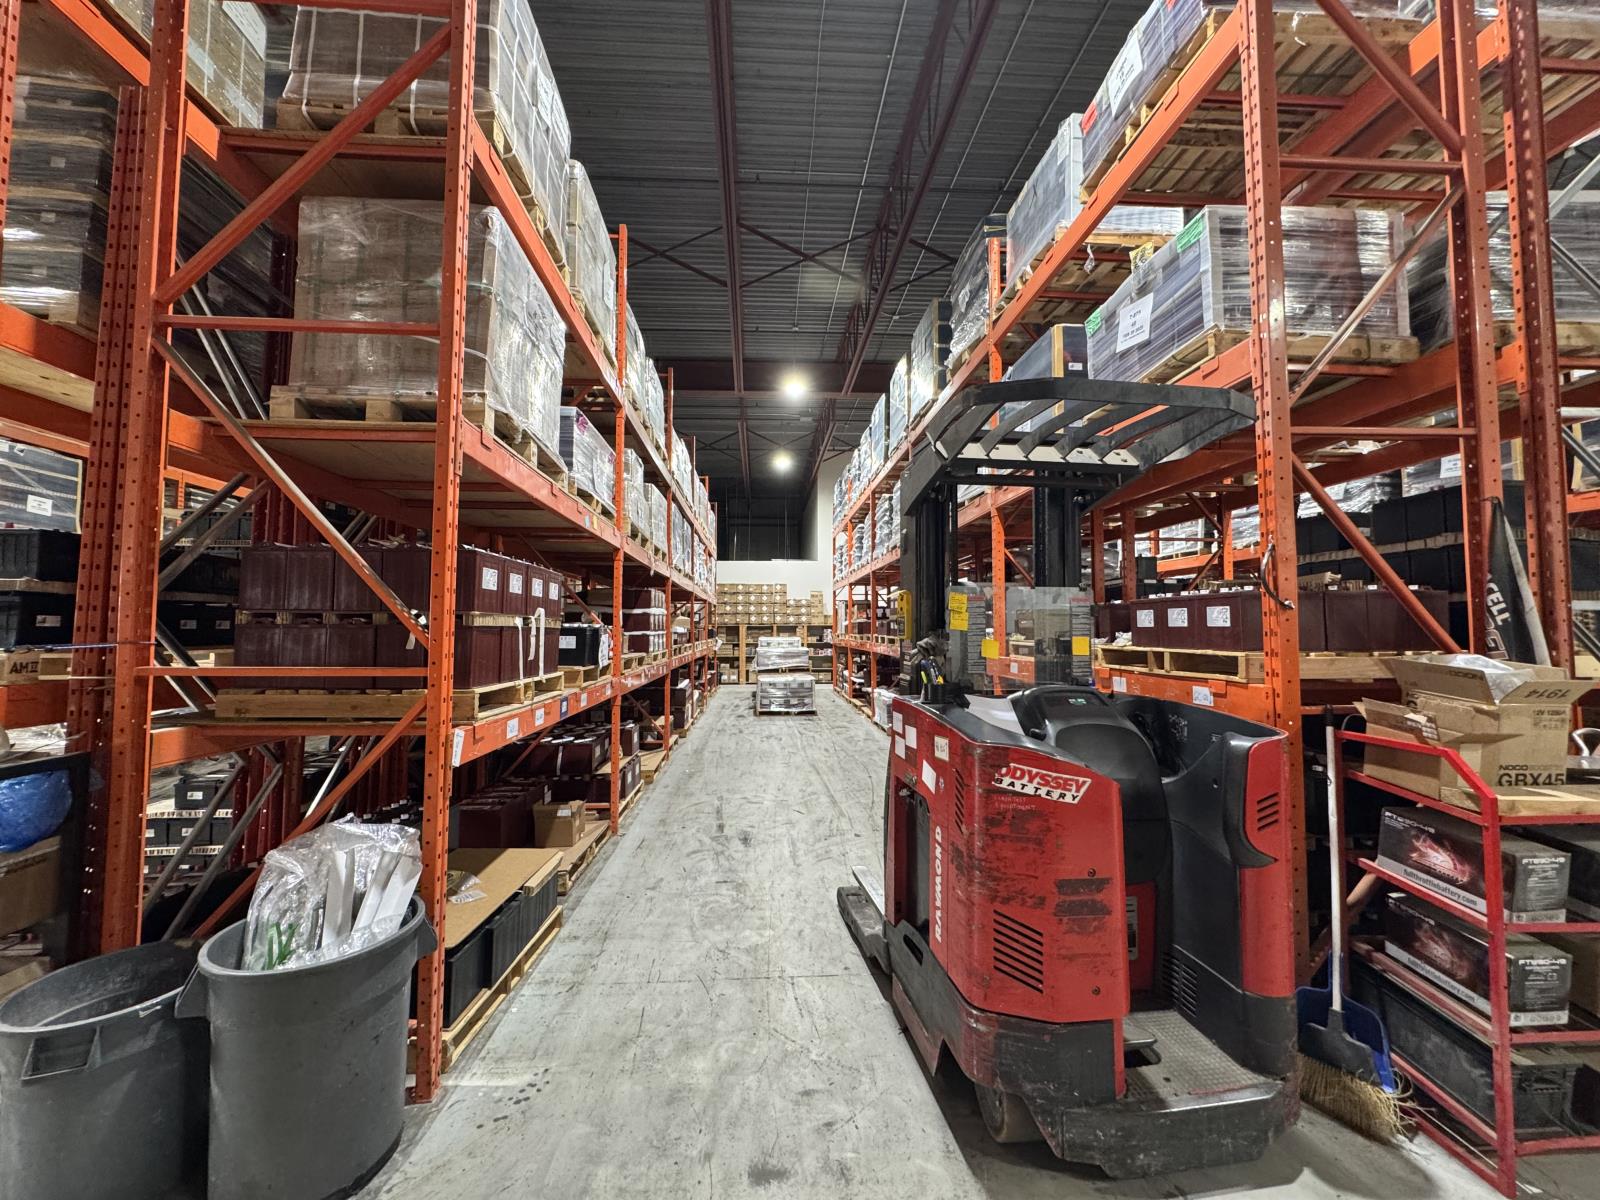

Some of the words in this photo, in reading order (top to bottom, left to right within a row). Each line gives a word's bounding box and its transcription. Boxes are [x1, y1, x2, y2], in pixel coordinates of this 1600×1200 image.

[1486, 573, 1511, 626] CELL
[994, 778, 1080, 802] BATTERY
[996, 766, 1089, 793] ODYSSEY
[1498, 773, 1565, 786] GBX45
[934, 825, 943, 944] RAYMOND
